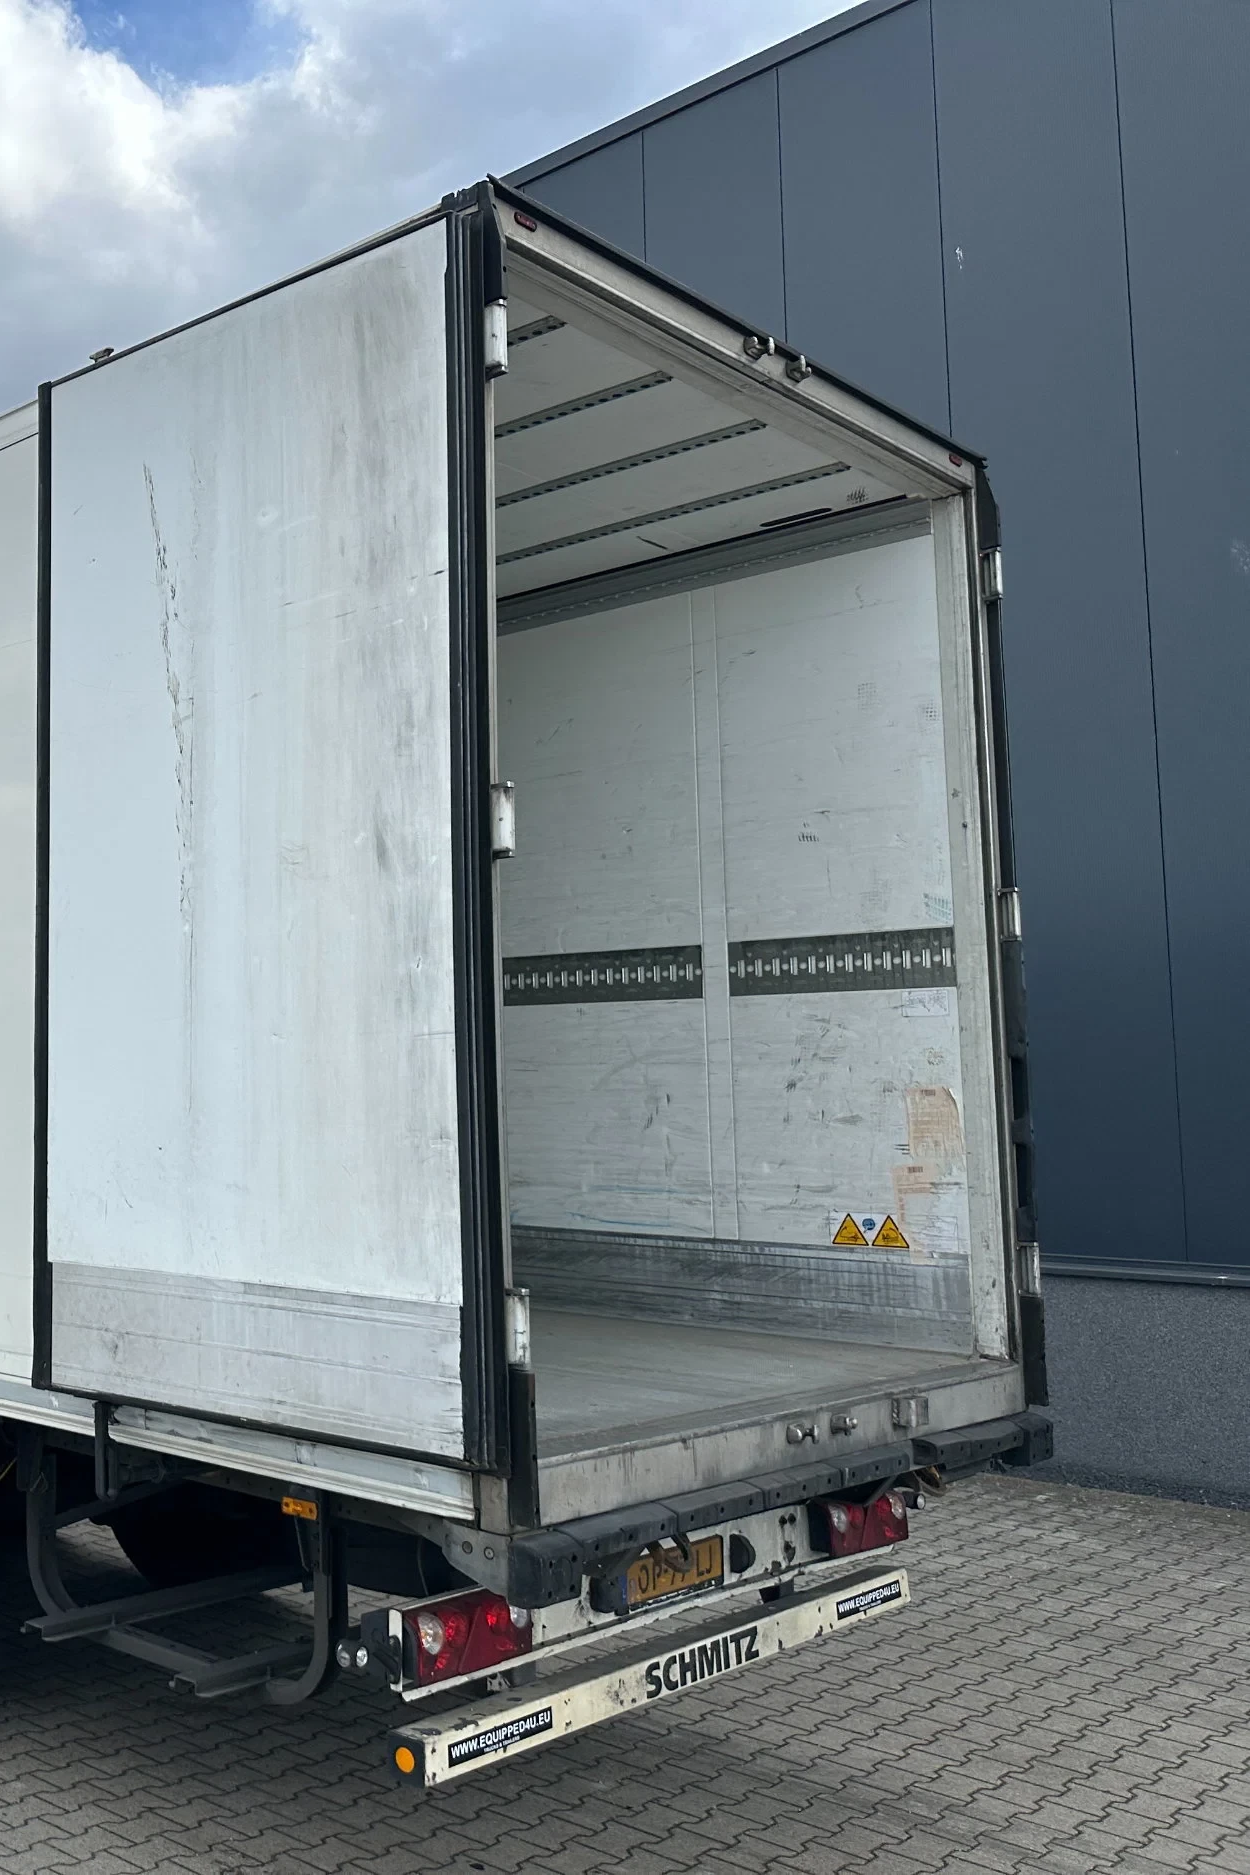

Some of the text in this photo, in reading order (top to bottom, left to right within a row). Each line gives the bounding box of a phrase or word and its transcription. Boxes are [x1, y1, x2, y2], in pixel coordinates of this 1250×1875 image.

[837, 1582, 899, 1614] WWW.EQUIPPED4U.EU
[645, 1625, 760, 1699] SCHMITZ
[450, 1710, 551, 1759] WWW.EQUIPPED4U.EU
